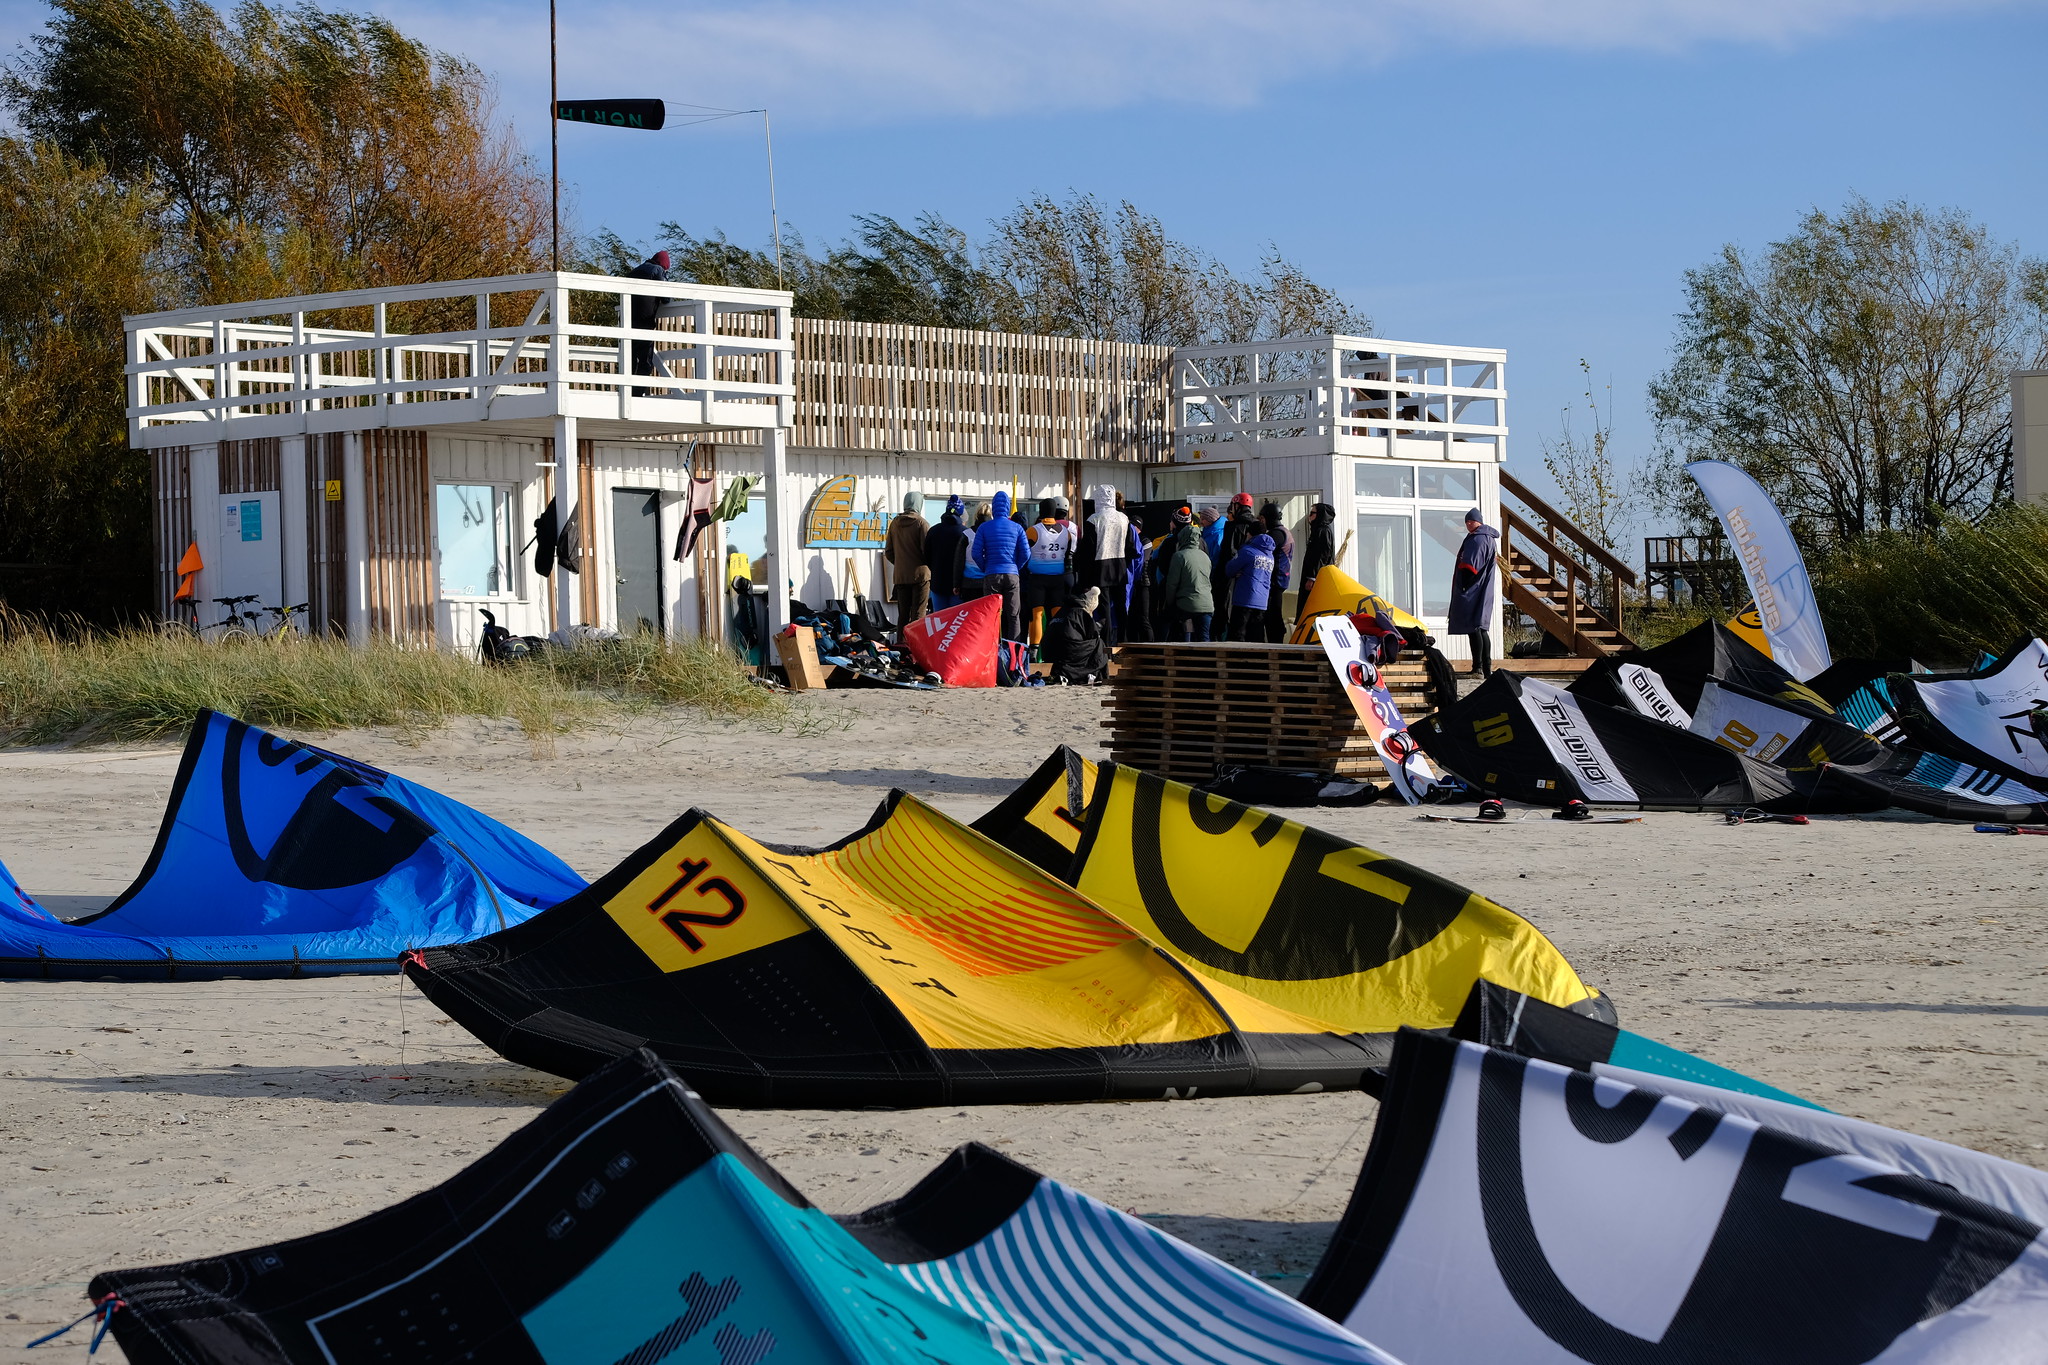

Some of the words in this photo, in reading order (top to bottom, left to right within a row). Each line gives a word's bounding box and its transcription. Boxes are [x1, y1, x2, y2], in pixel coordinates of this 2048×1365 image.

[560, 108, 643, 127] NORTH
[811, 518, 892, 541] SURFIKL
[1048, 543, 1060, 551] 23
[938, 610, 969, 652] FANATIC
[1472, 712, 1514, 747] 10
[1531, 694, 1612, 785] FLUID
[646, 857, 747, 954] 12
[762, 856, 958, 998] ORBIT
[1091, 979, 1114, 998] BIG
